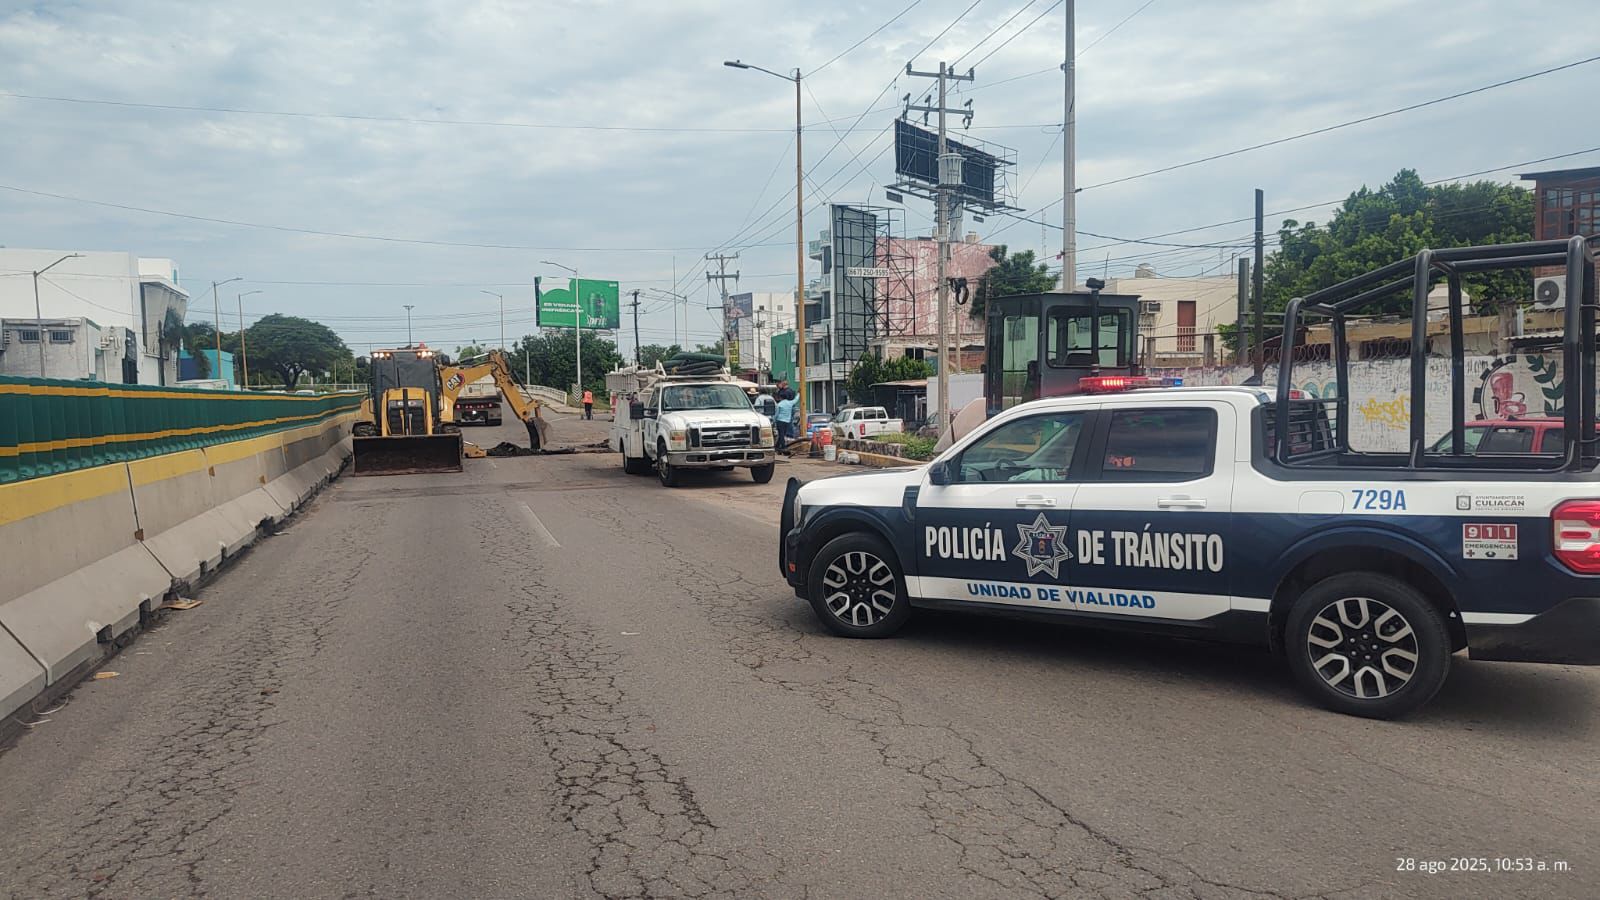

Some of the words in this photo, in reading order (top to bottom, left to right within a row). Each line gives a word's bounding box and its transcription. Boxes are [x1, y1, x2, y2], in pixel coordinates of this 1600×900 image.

[1351, 489, 1407, 511] 729A
[1467, 526, 1512, 538] 911
[925, 522, 1007, 562] POLICÍA
[1077, 529, 1105, 565] DE
[1110, 522, 1224, 573] TRÁNSITO
[967, 583, 1032, 599] UNIDAD
[1037, 588, 1061, 602] DE
[1064, 589, 1156, 609] VIALIDAD
